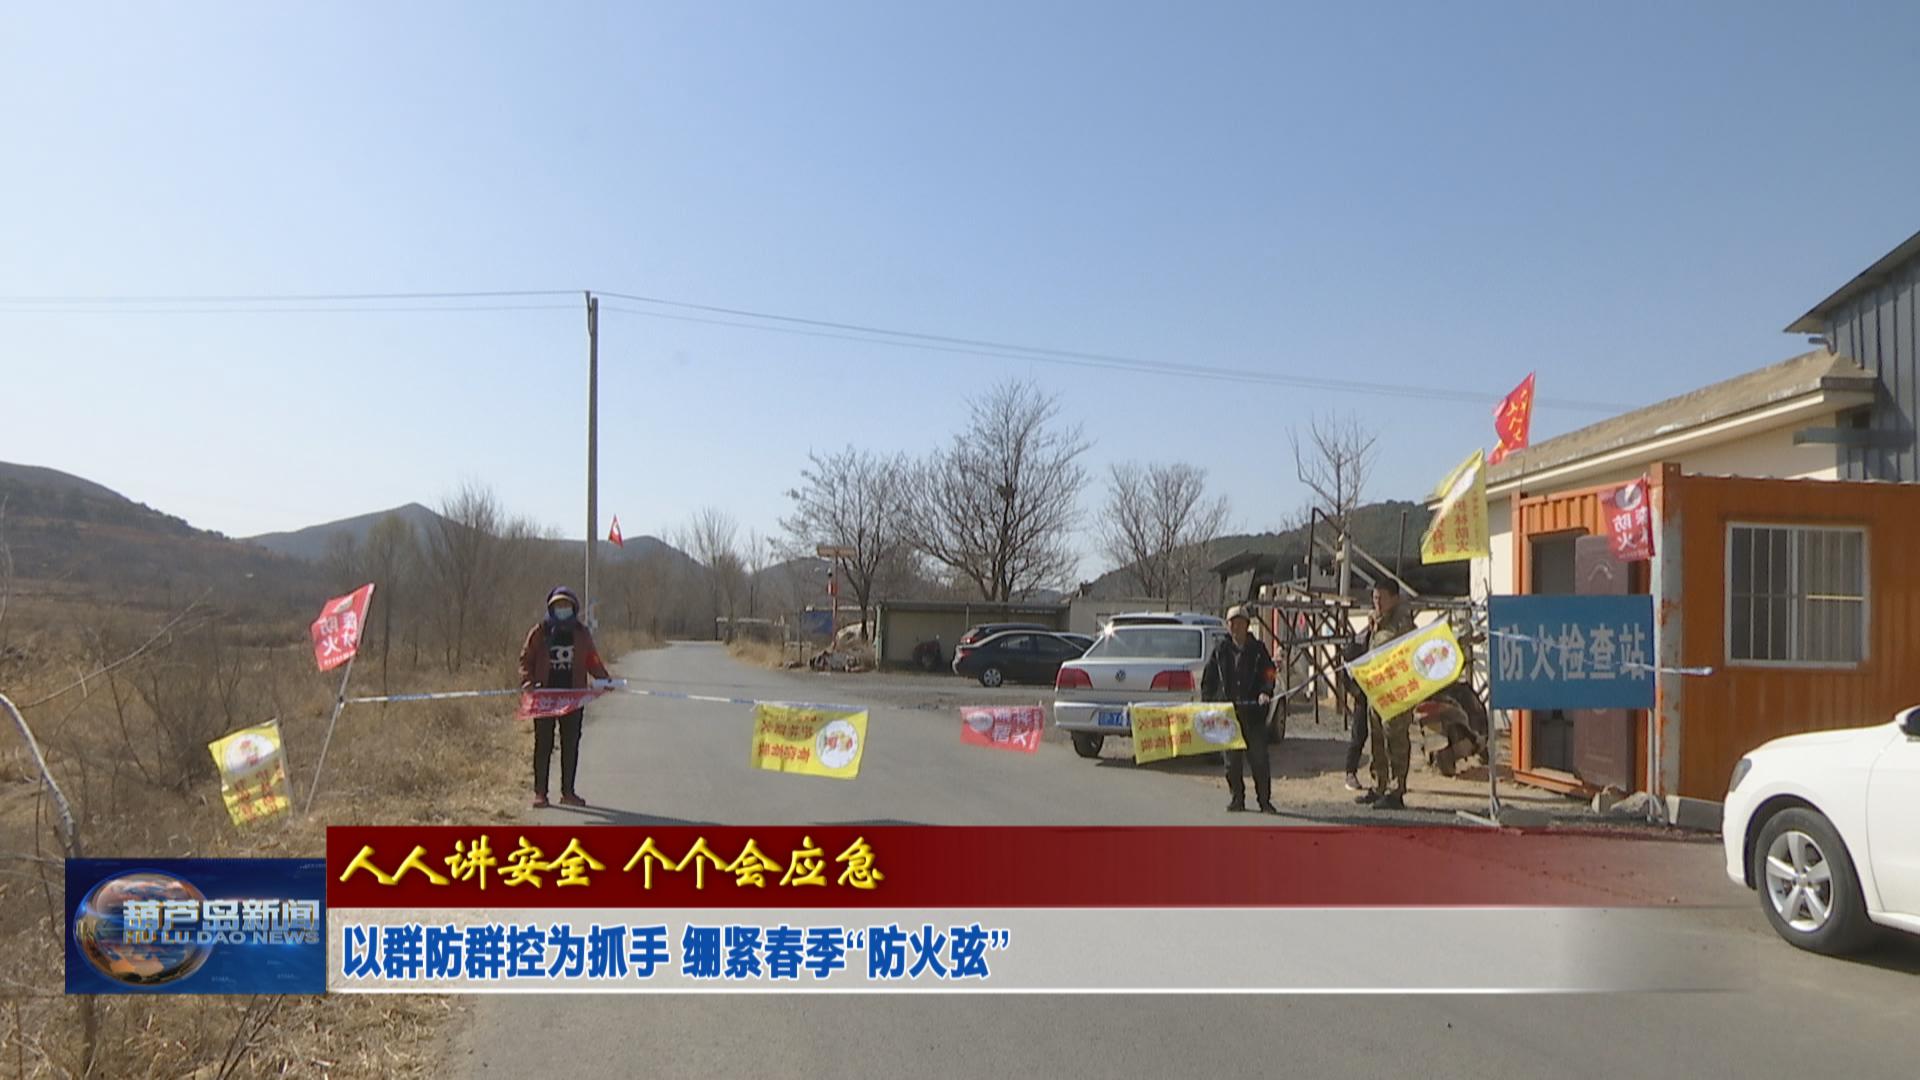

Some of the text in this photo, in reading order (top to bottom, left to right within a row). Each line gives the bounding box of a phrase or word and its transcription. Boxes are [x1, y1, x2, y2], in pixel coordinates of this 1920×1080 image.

[1498, 623, 1648, 681] 防火检查站
